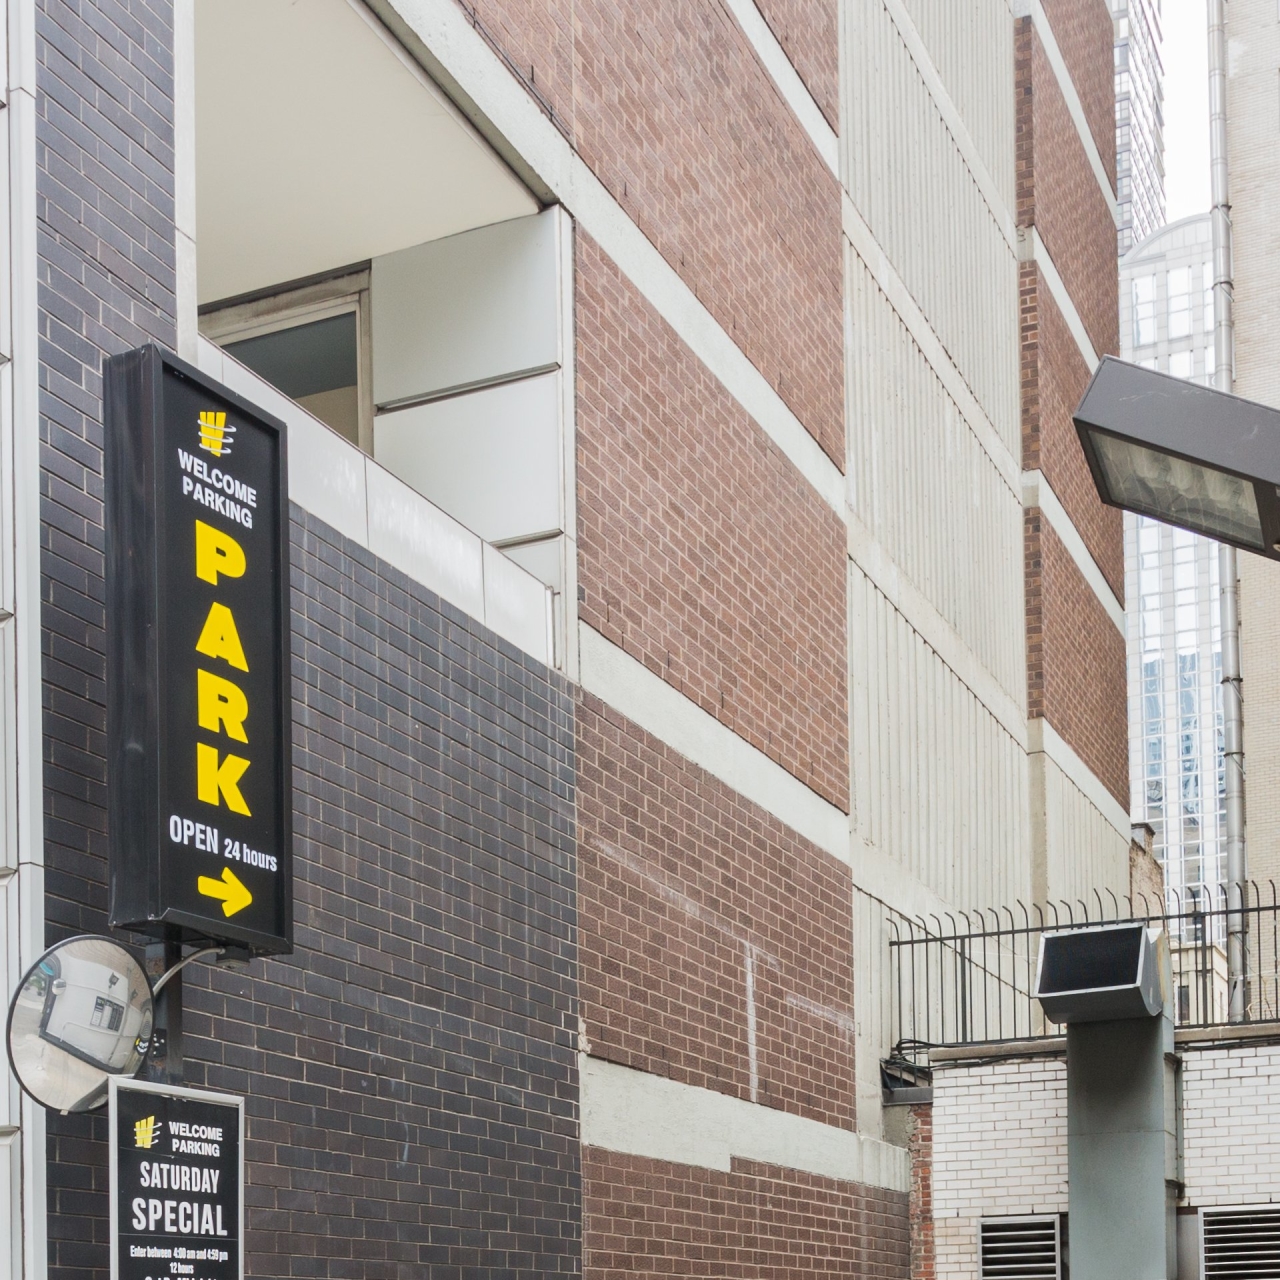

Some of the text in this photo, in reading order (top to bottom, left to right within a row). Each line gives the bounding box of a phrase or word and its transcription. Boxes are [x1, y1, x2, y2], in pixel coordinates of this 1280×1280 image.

[178, 448, 257, 508] WELCOME
[182, 475, 253, 529] PARKING
[196, 519, 252, 817] PARK
[169, 815, 278, 872] OPEN 24 hours
[169, 1121, 223, 1141] WELCOME
[172, 1139, 220, 1157] PARKING
[140, 1161, 220, 1194] SATURDAY
[132, 1197, 228, 1236] SPECIAL
[169, 1262, 194, 1274] 12 hours
